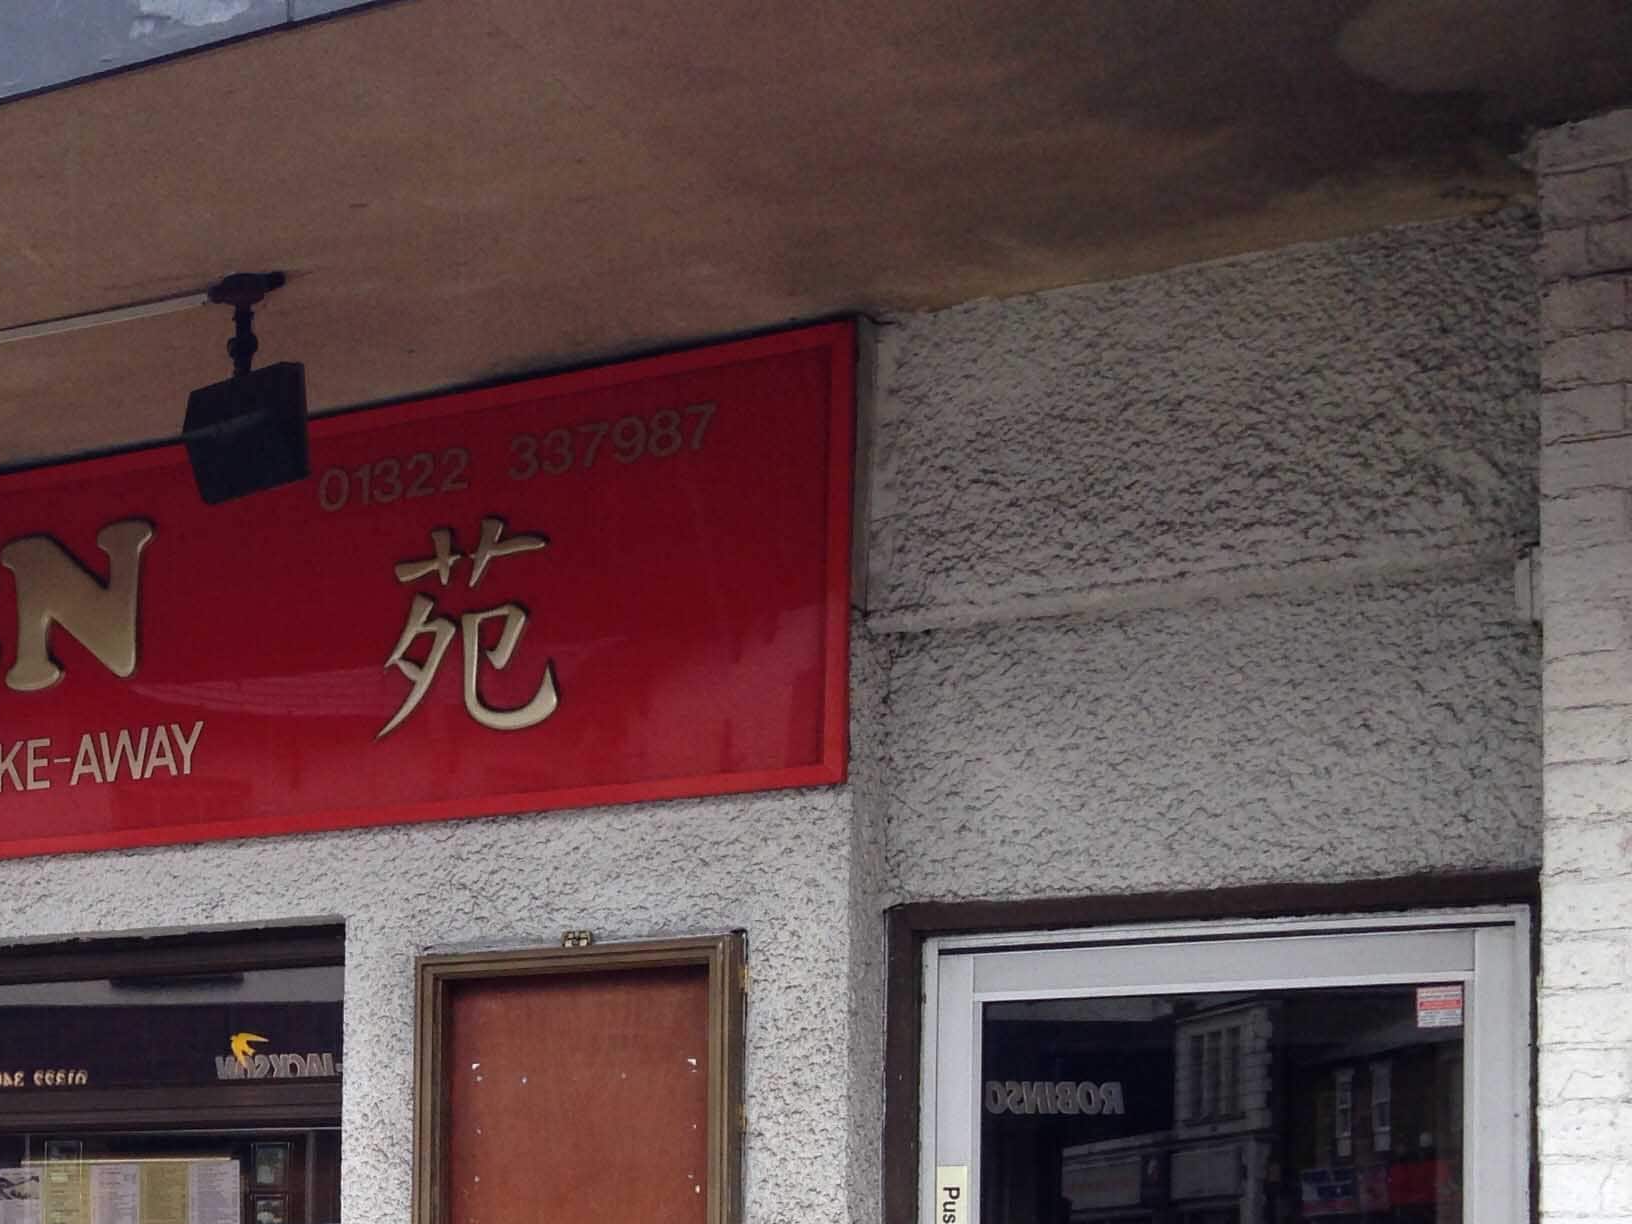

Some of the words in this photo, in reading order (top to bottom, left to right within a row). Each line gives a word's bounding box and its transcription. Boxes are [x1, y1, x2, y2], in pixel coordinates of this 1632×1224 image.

[317, 447, 469, 512] 01322
[507, 404, 717, 481] 337987
[376, 516, 560, 742] 苑
